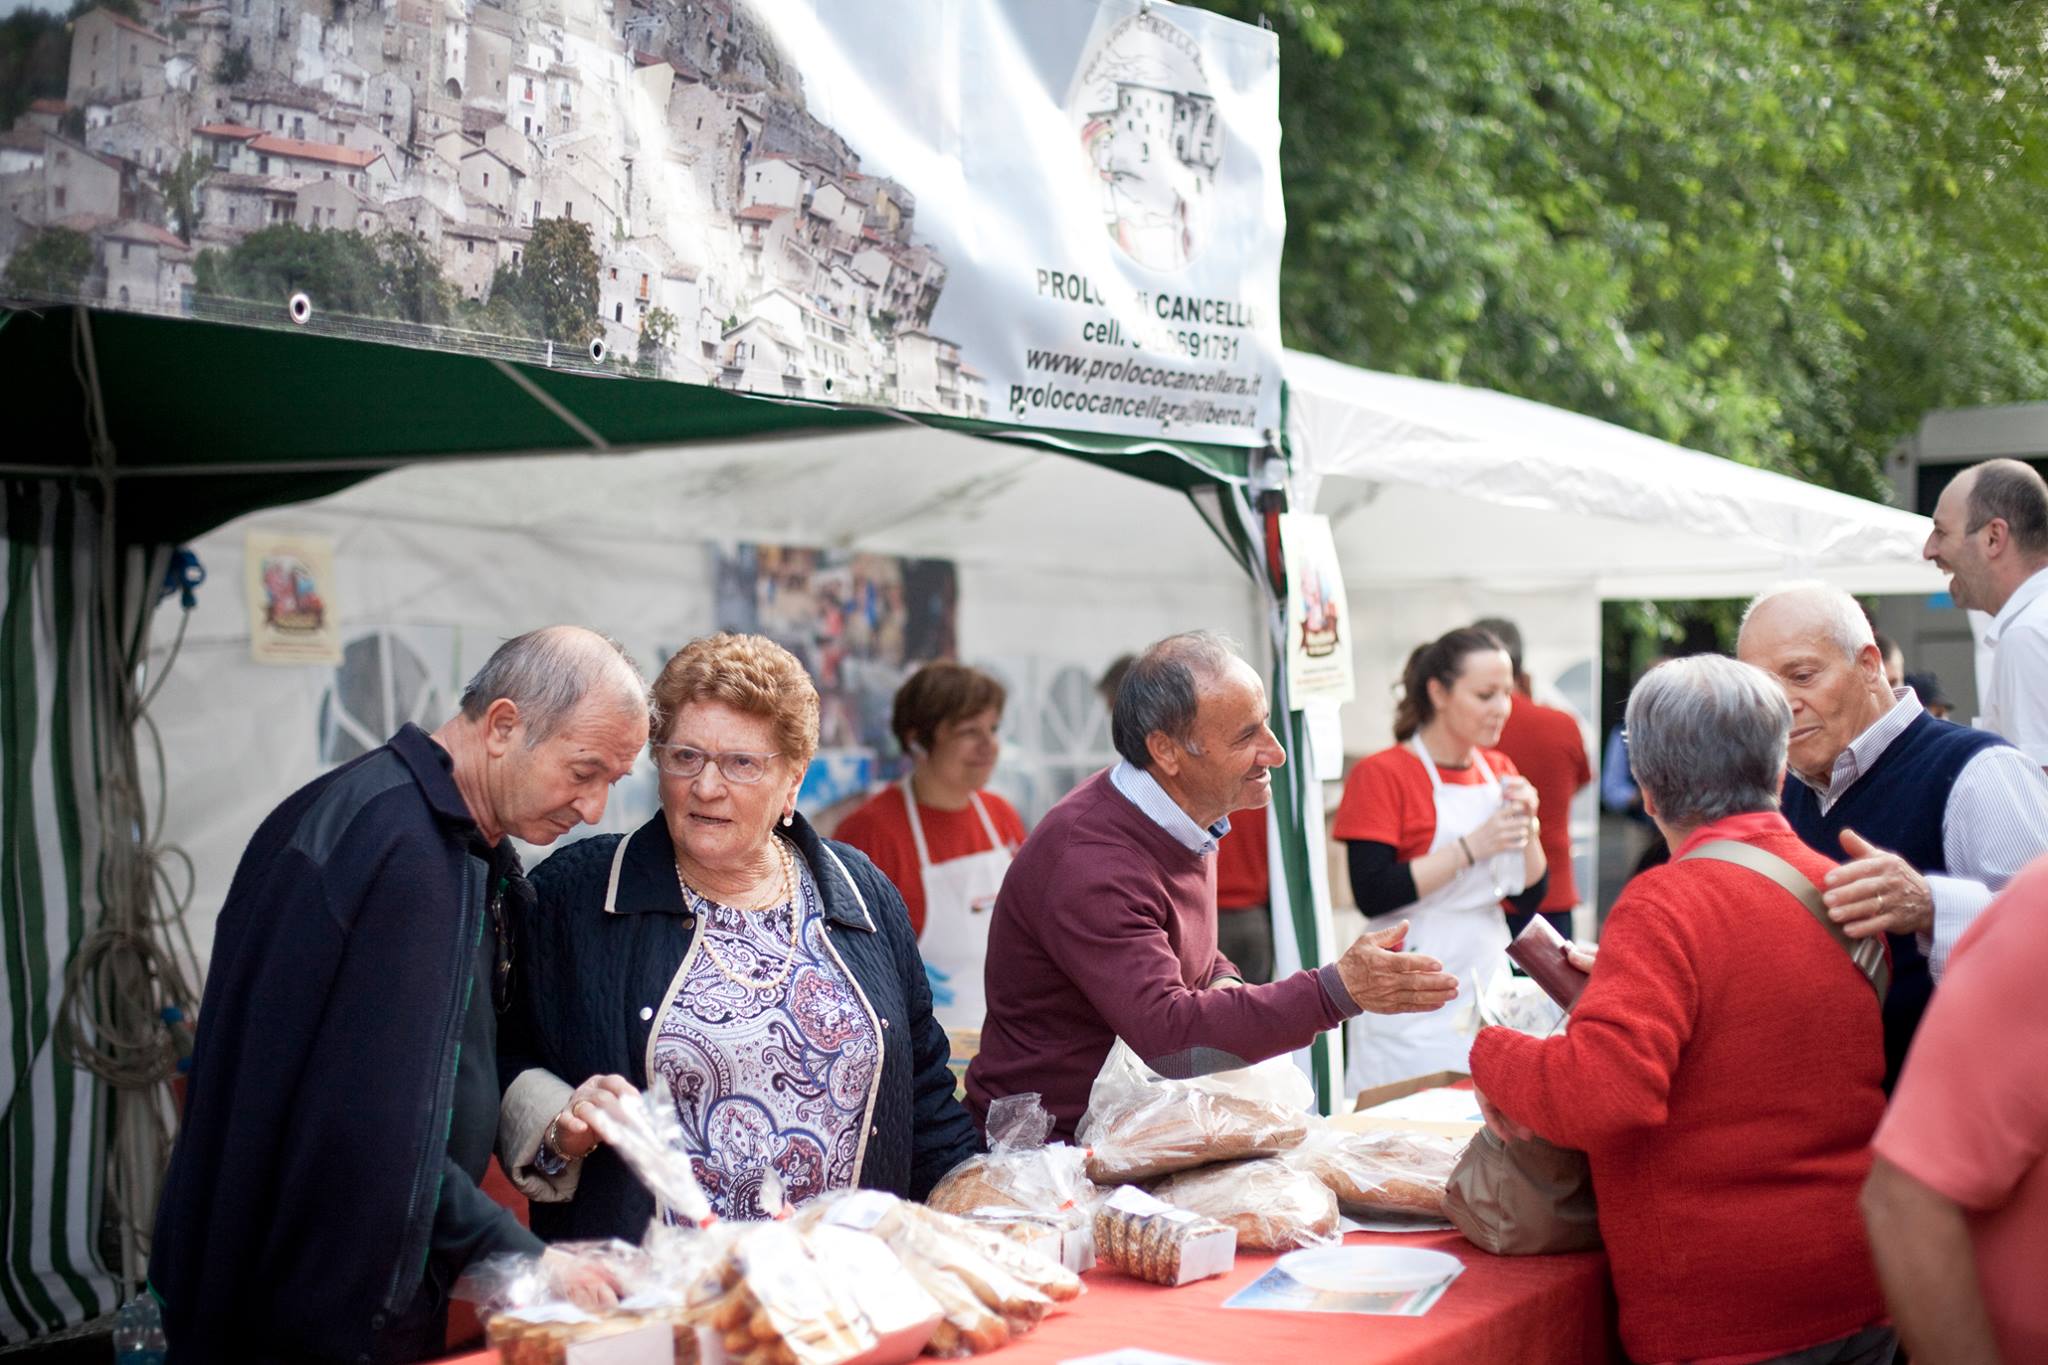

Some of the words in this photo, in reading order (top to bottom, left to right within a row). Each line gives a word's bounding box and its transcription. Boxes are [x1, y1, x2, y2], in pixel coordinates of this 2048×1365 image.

[1036, 268, 1105, 306] PROL
[1083, 319, 1125, 346] cell.
[1026, 349, 1263, 397] www.prolococancellara.it
